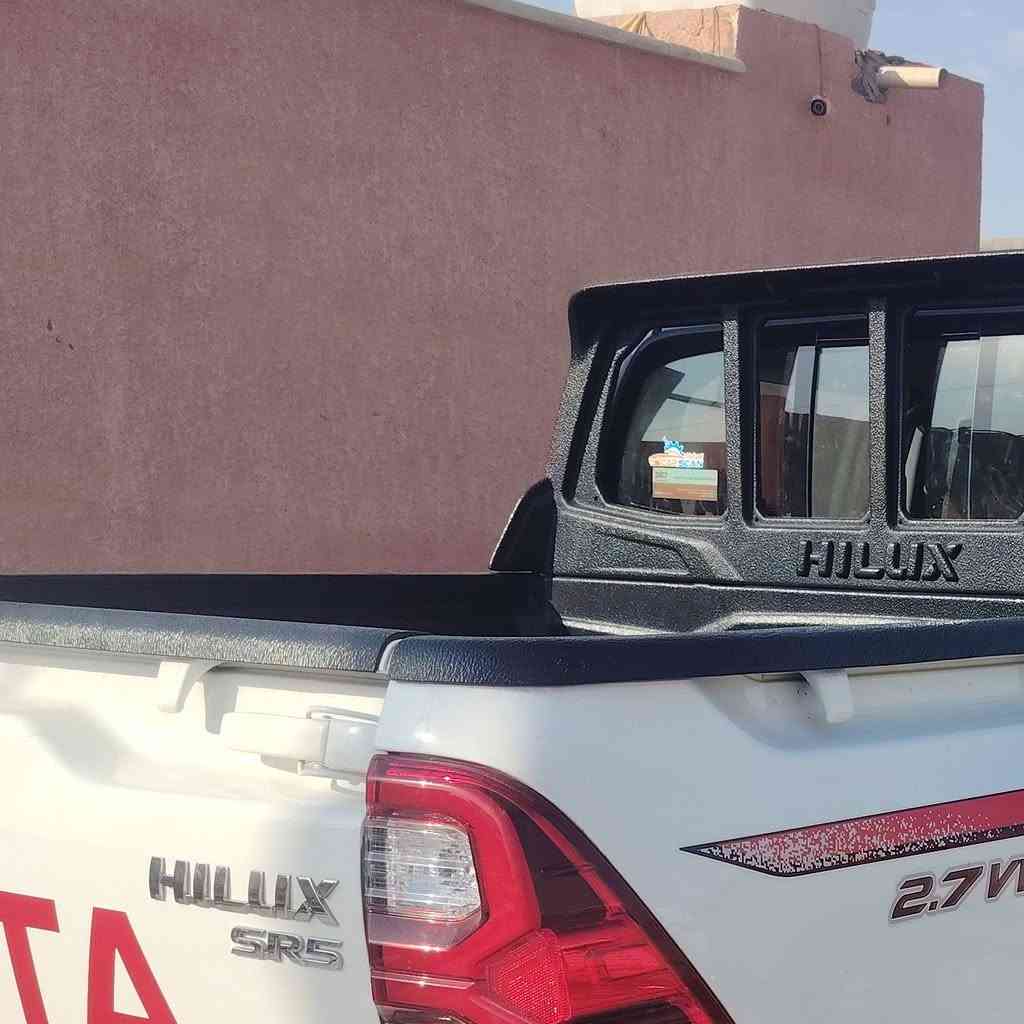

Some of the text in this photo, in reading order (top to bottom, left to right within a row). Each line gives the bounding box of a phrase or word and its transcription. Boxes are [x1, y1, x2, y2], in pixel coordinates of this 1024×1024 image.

[797, 540, 963, 582] HILUX
[148, 856, 341, 927] HILUX
[890, 865, 984, 921] 2.7
[230, 925, 344, 970] SR5
